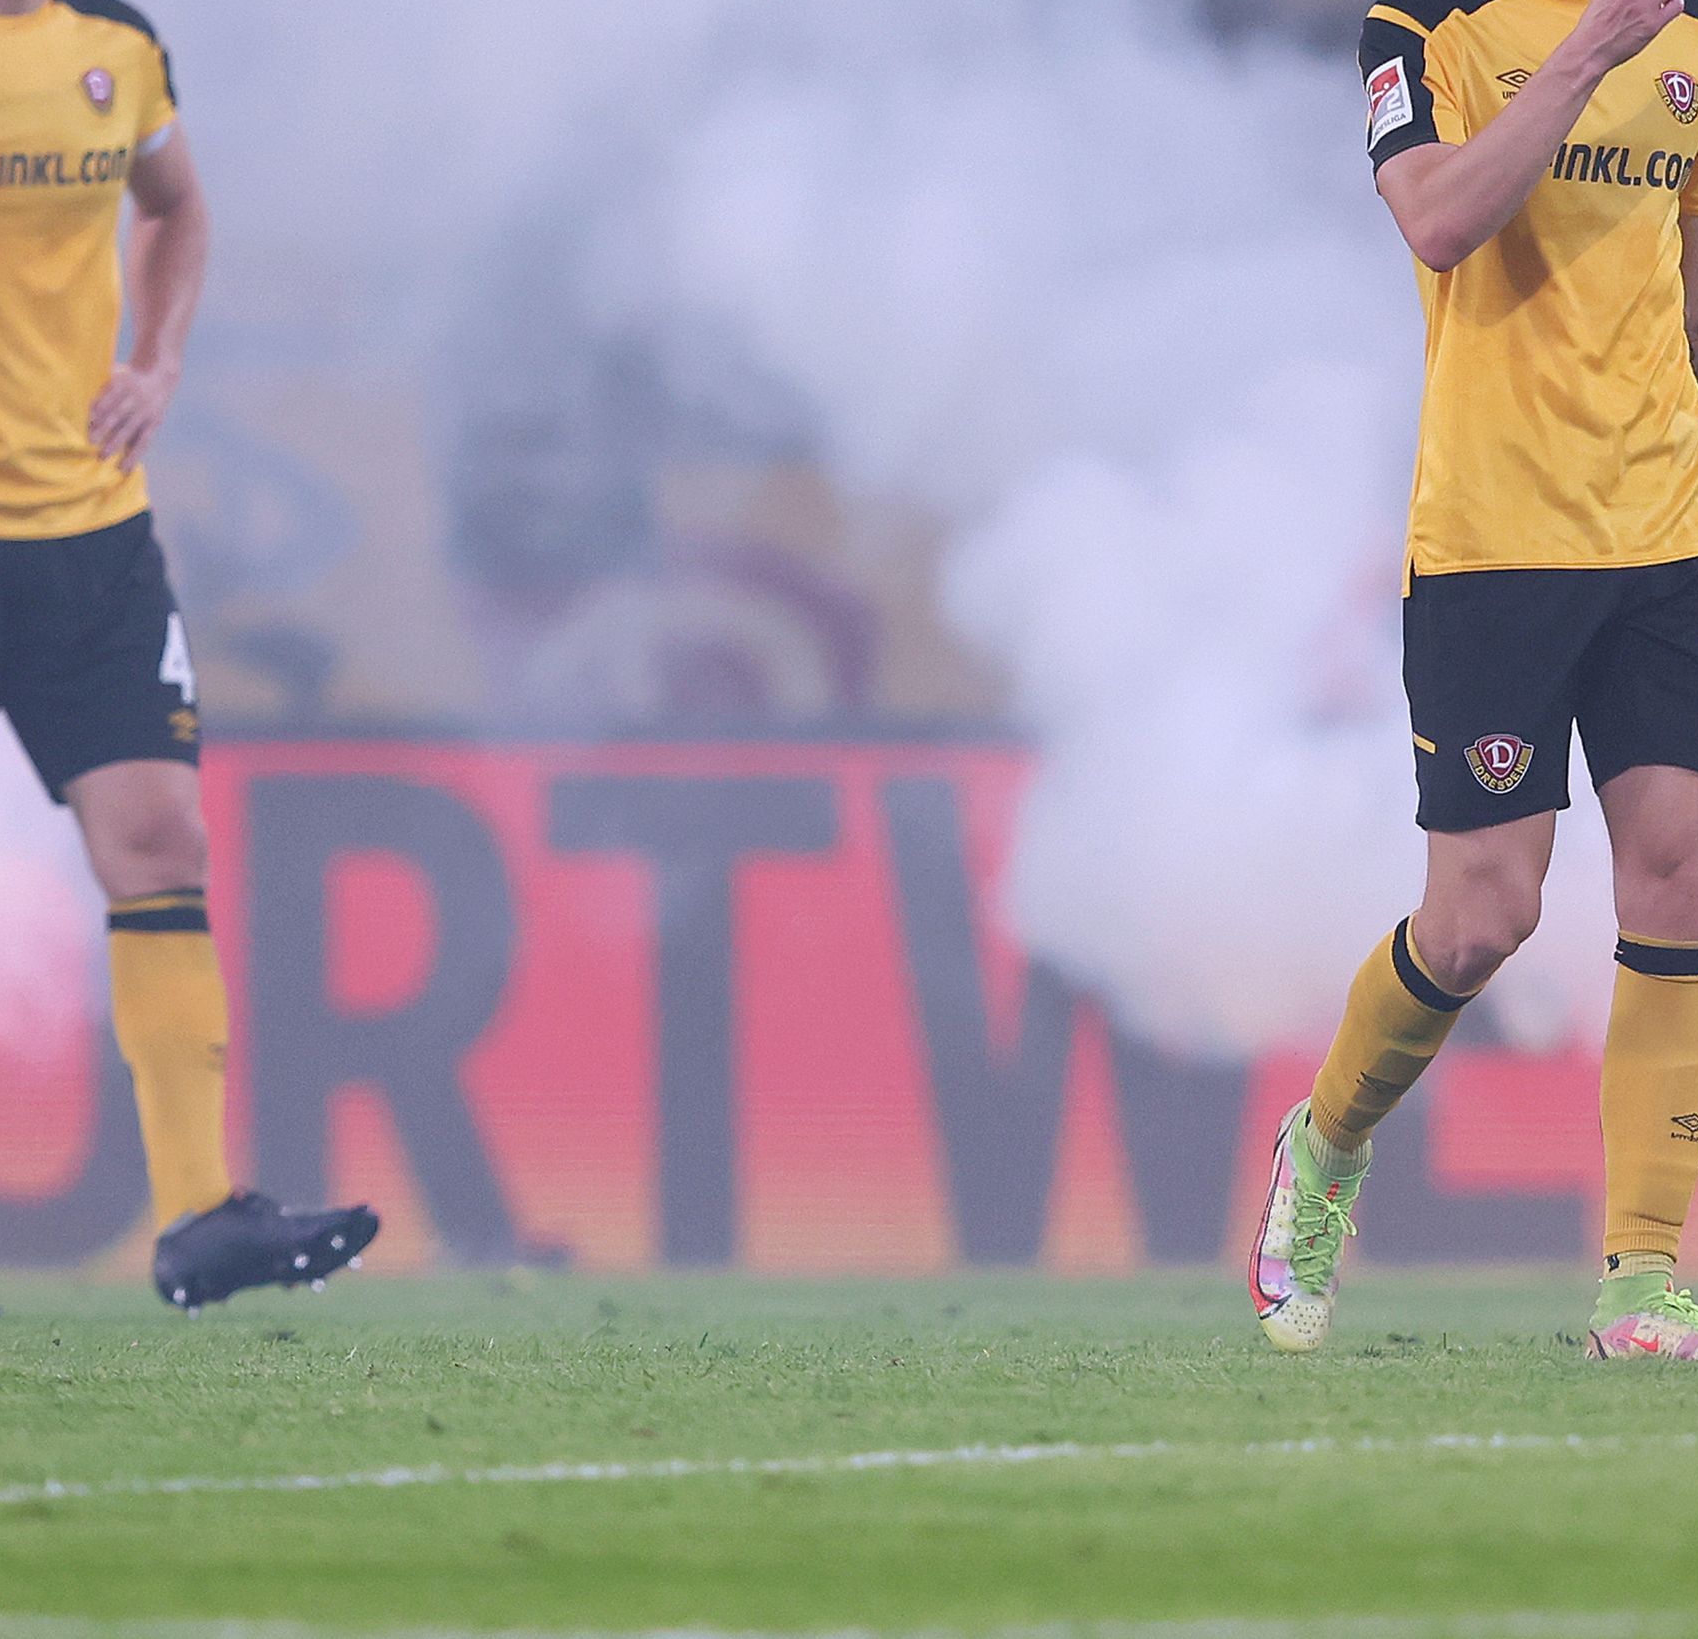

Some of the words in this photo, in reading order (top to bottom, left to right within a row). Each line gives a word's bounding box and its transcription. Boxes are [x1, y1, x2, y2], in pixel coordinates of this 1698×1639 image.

[158, 611, 196, 704] 4
[1484, 739, 1514, 769] D
[1475, 763, 1525, 790] DRESDEN
